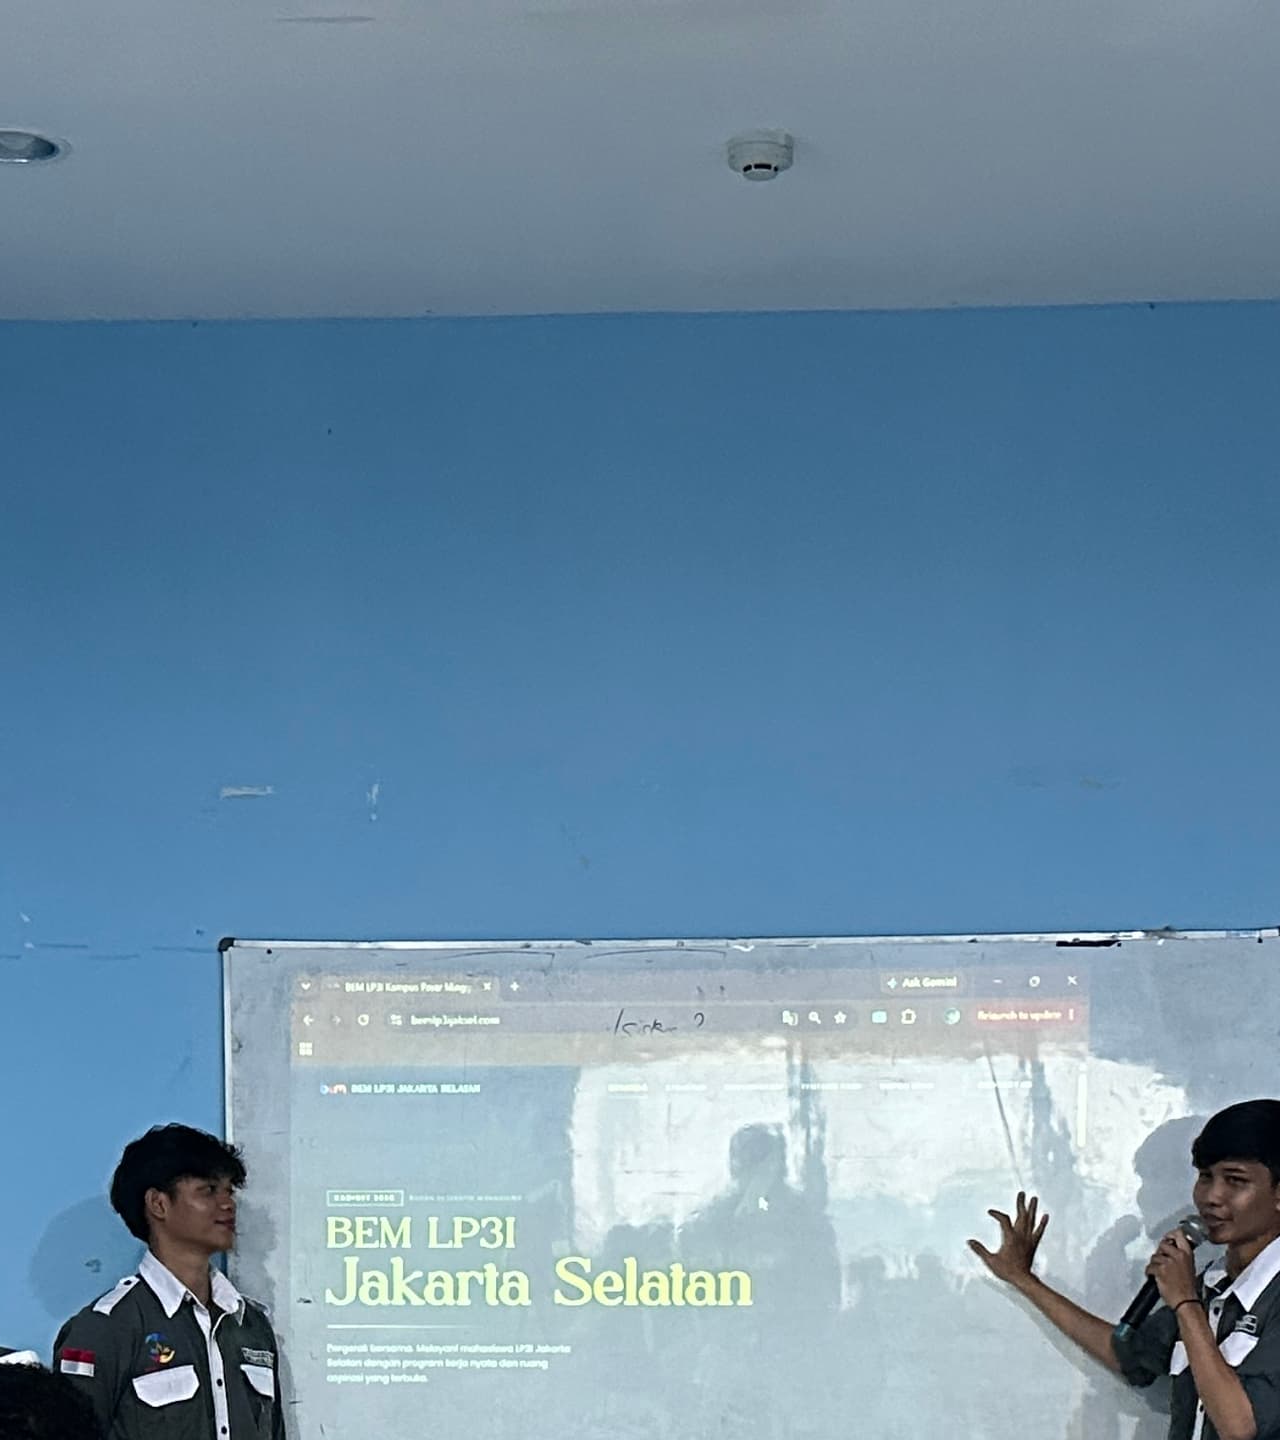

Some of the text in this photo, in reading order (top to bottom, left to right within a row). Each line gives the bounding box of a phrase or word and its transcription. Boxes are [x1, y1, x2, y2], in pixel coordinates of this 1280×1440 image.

[922, 976, 957, 988] Gemini
[397, 1084, 438, 1094] JAKARTA
[326, 1217, 516, 1249] BEM LP3I
[325, 1256, 753, 1307] Jakarta Selatan
[535, 1344, 571, 1353] Jakarta
[327, 1358, 362, 1368] Selatan
[402, 1359, 444, 1370] program
[499, 1358, 518, 1368] dan
[520, 1360, 549, 1370] ruang
[365, 1375, 390, 1385] yang
